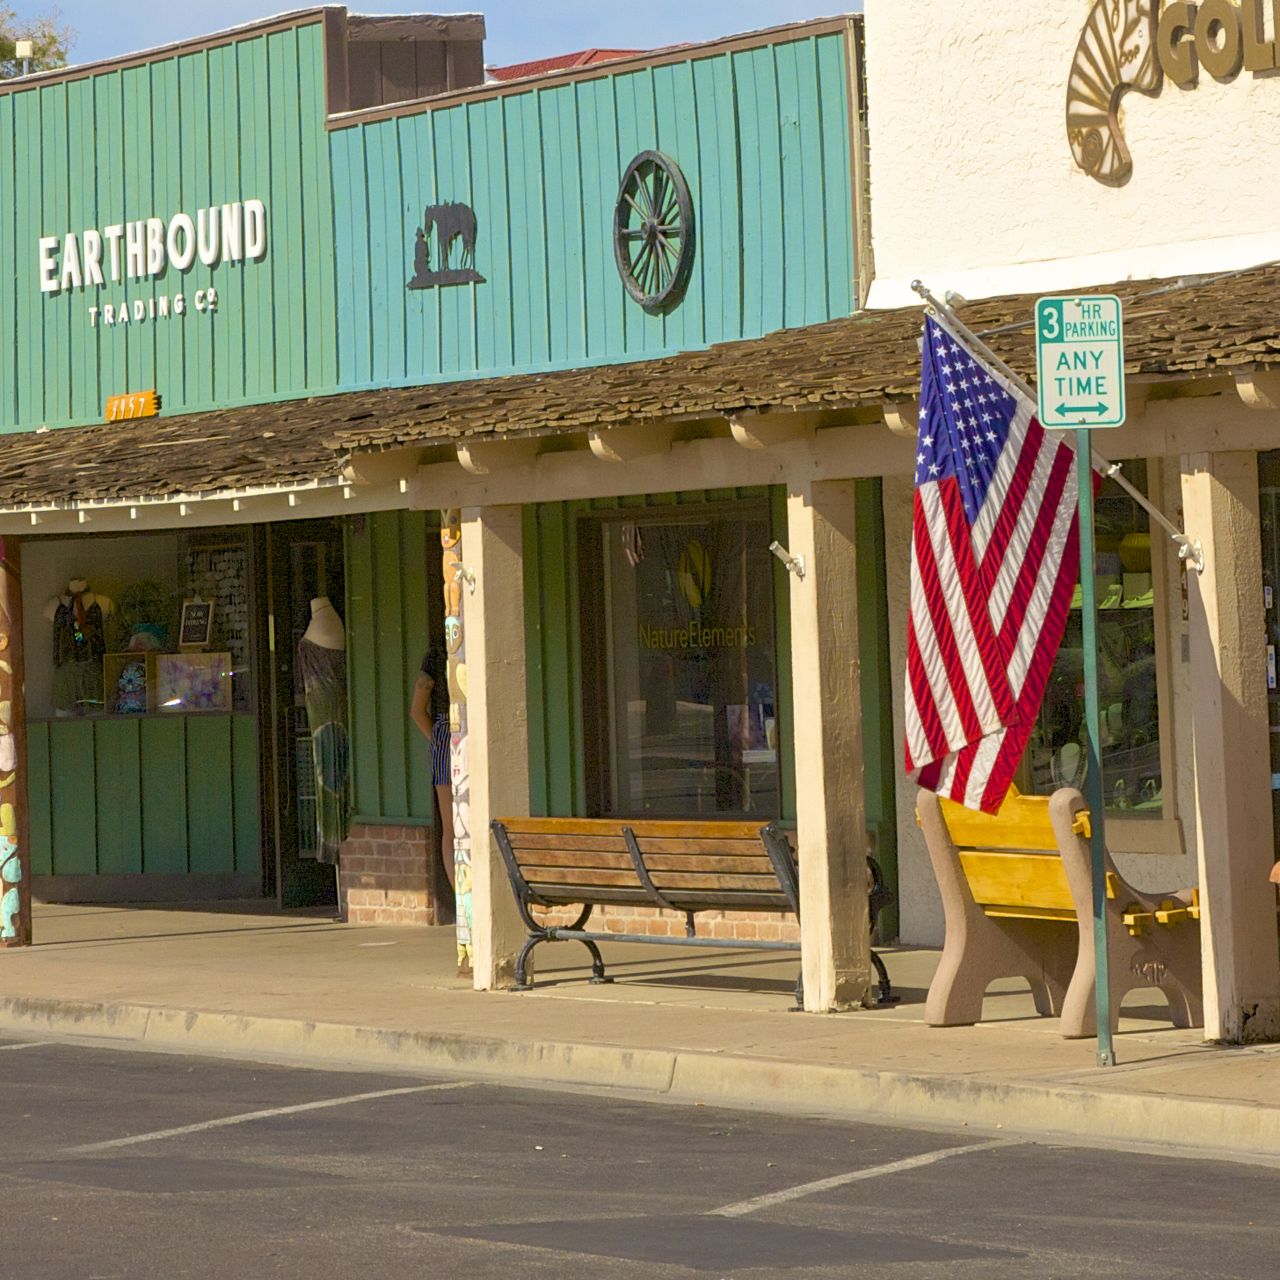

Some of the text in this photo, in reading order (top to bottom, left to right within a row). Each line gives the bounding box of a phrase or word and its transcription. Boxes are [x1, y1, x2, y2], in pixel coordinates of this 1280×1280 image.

[38, 199, 267, 293] EARTHBOUND
[88, 293, 186, 327] TRADING
[1042, 304, 1102, 339] 3 HR
[1065, 320, 1116, 337] PARKING
[1056, 350, 1104, 371] ANY
[1054, 376, 1108, 397] TIME
[110, 397, 146, 420] 3957
[640, 621, 756, 649] NatureElements
